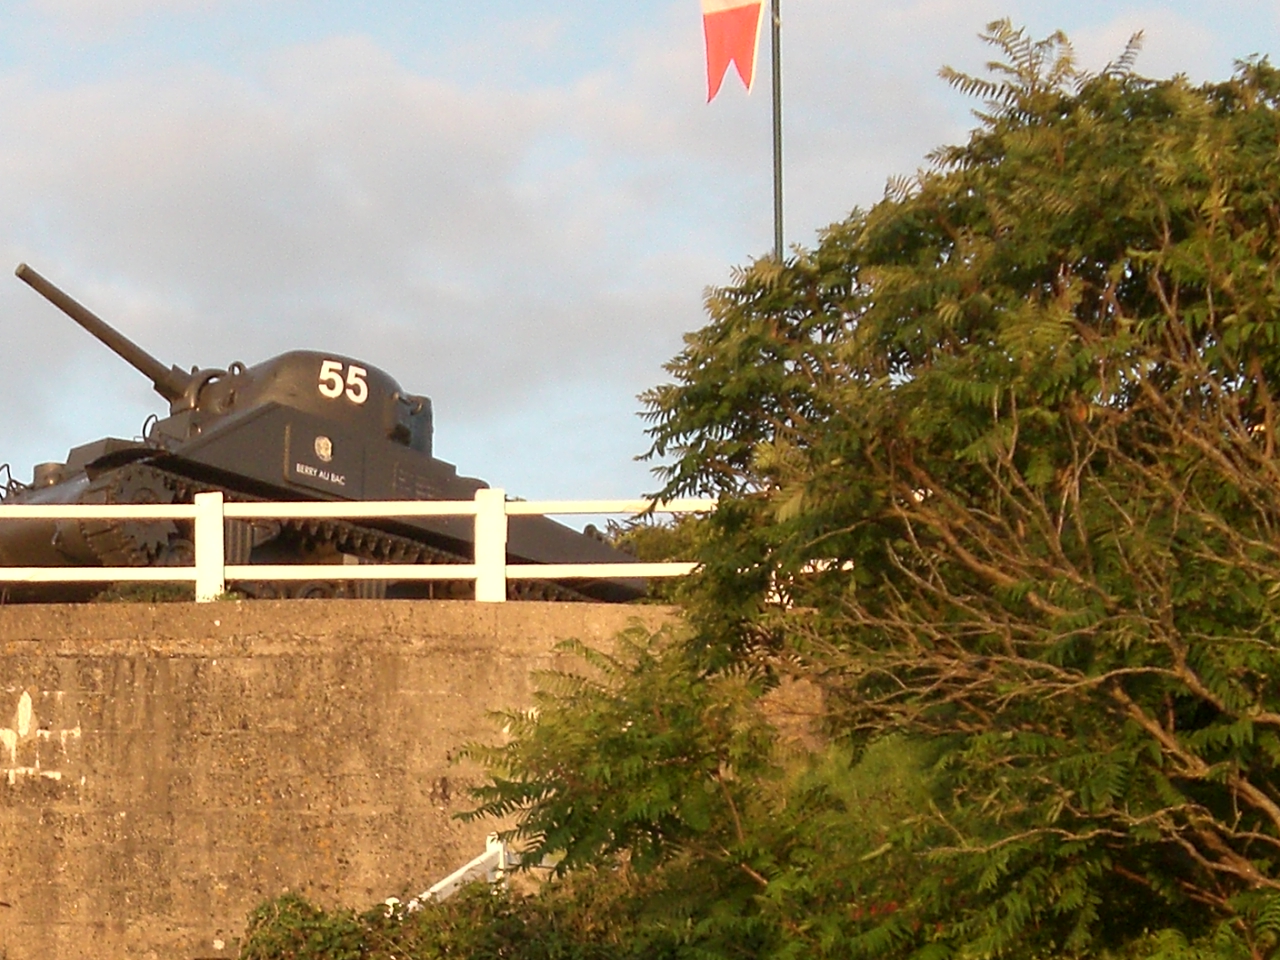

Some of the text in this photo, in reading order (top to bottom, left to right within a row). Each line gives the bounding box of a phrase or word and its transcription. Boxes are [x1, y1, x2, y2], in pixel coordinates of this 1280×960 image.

[318, 360, 368, 404] 55
[296, 463, 346, 486] BERRY AU BAC
